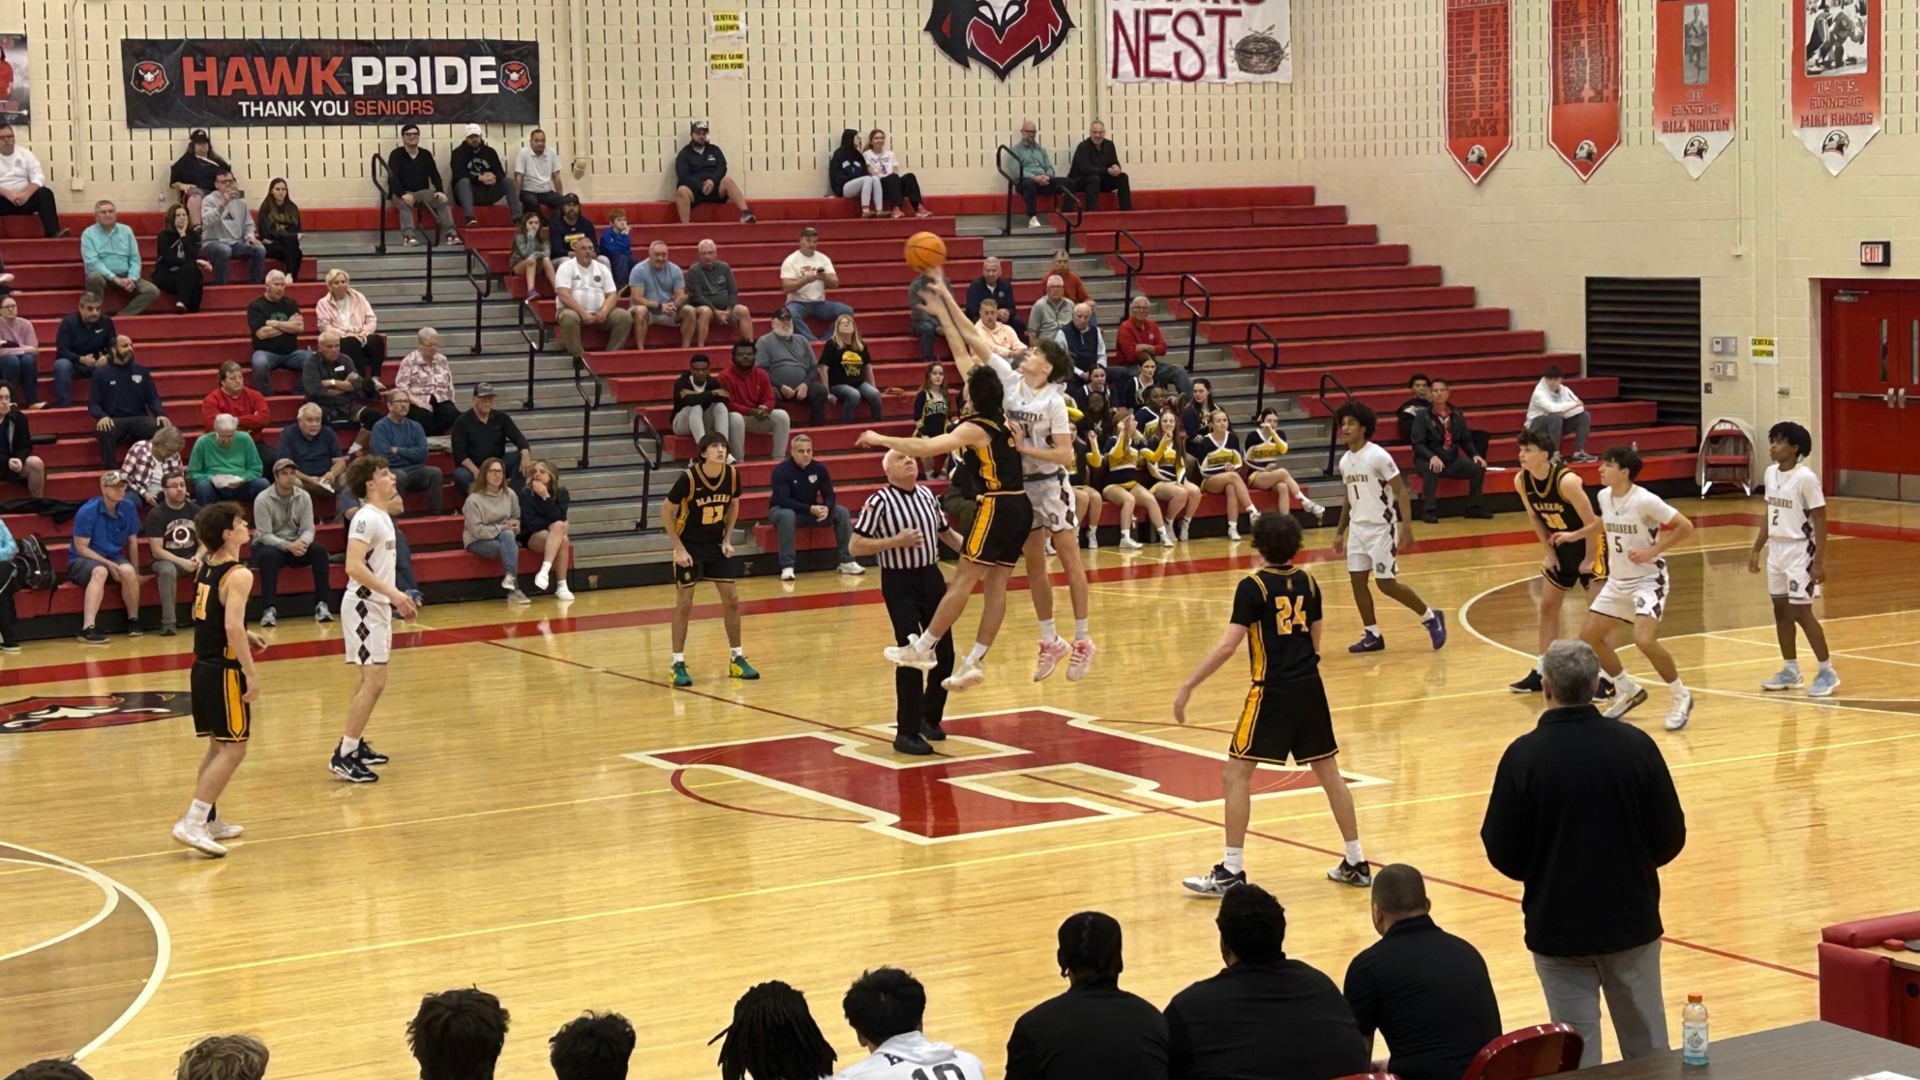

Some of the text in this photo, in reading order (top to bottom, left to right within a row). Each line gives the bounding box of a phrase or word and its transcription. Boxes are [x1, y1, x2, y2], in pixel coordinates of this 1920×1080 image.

[1112, 8, 1242, 82] NEST
[181, 56, 499, 97] HAWK PRIDE
[238, 100, 434, 117] THANK YOU SENIORS
[1662, 119, 1730, 134] BILL NORTON
[1800, 112, 1874, 128] MIKE RHOADS
[1864, 244, 1880, 261] EXIT
[1353, 484, 1360, 500] 1
[1772, 508, 1780, 526] 2
[1614, 535, 1623, 553] 5
[1274, 594, 1309, 636] 24
